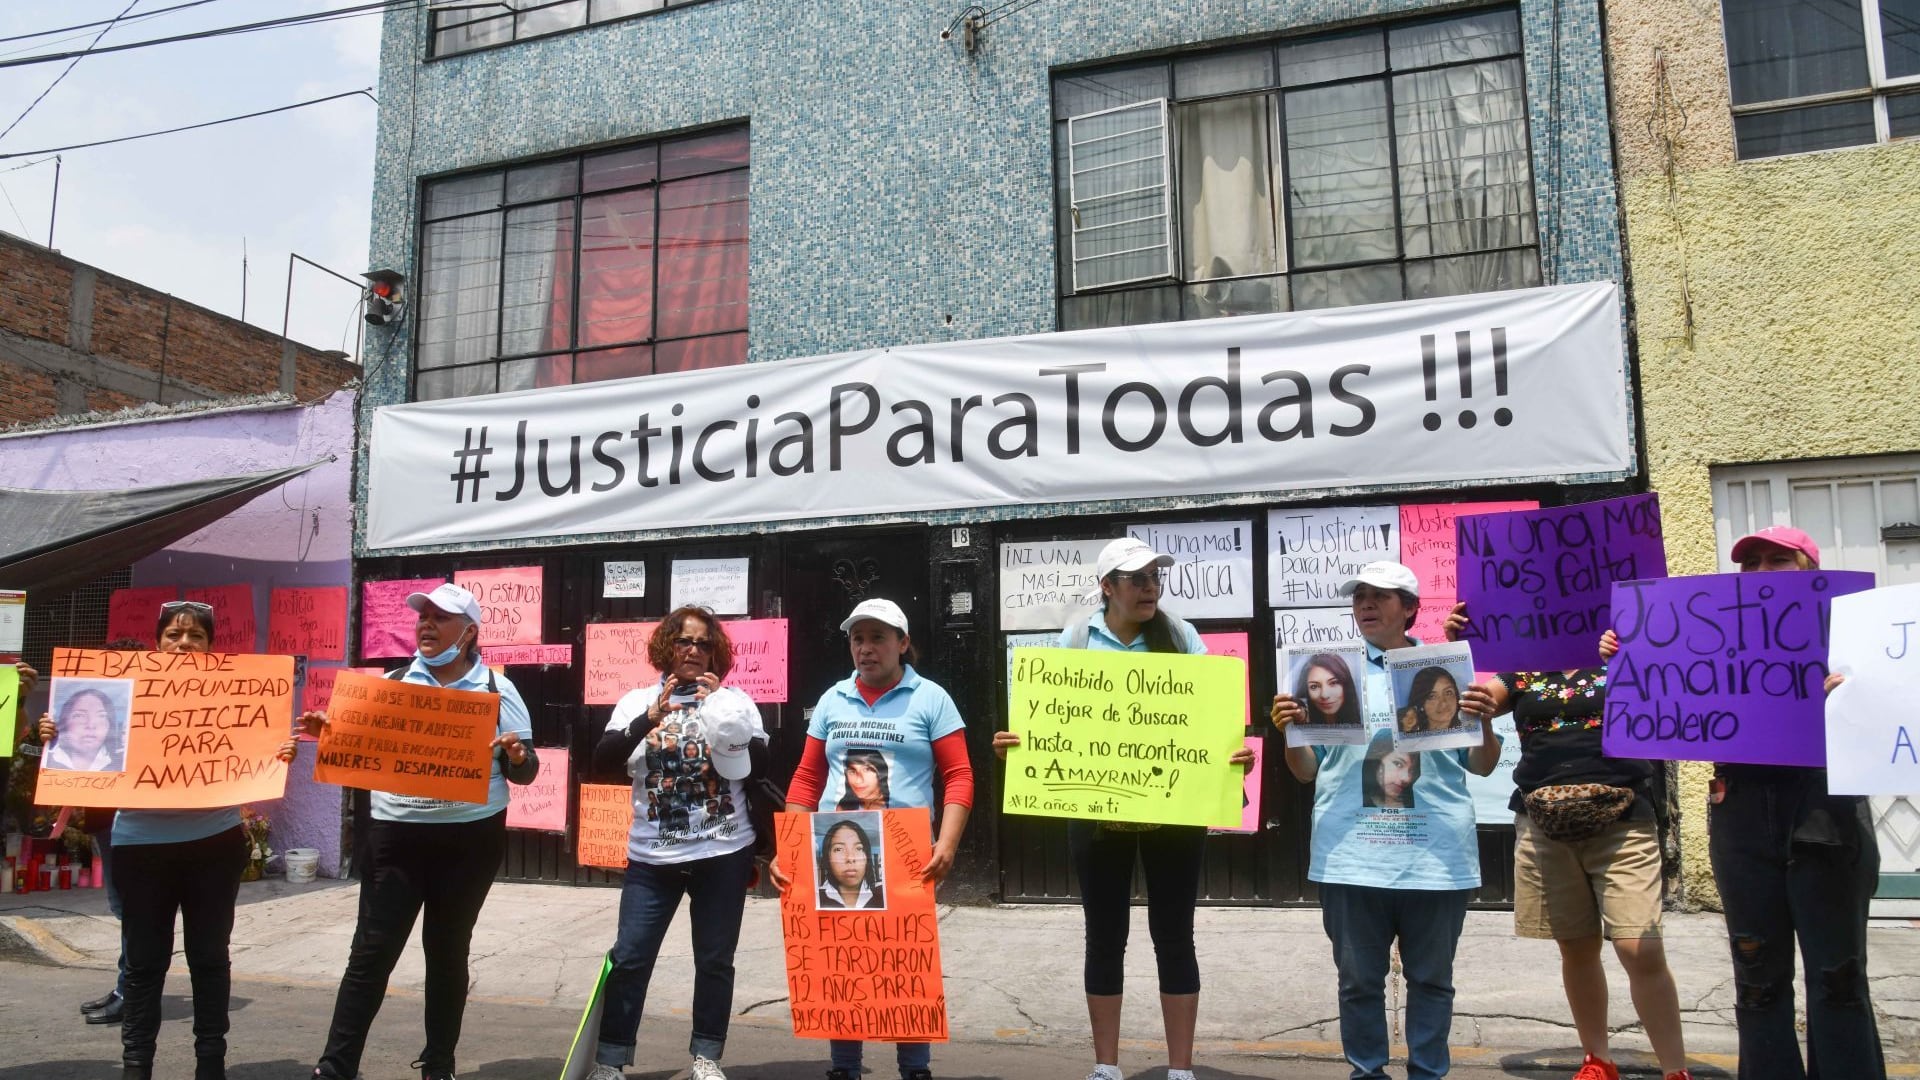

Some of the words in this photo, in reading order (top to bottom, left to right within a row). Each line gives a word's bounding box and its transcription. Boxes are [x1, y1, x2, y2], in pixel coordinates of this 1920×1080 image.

[450, 347, 1377, 504] #JusticiaParaTodas
[1421, 327, 1514, 431] !!!
[953, 529, 968, 543] 18
[1277, 514, 1392, 555] ¡Justicia!
[1040, 548, 1082, 566] UNA
[1281, 556, 1320, 580] para
[1481, 558, 1547, 594] nos
[489, 582, 541, 604] estamos
[1072, 594, 1102, 606] TOD
[587, 625, 607, 641] Las
[131, 704, 270, 730] JUSTICIA
[860, 720, 897, 731] MICHAEL
[1102, 706, 1121, 723] de
[1605, 700, 1739, 743] Roblero
[161, 731, 234, 757] PARA
[861, 730, 905, 743] MARTÍNEZ
[1089, 738, 1111, 757] no
[318, 751, 382, 771] MUJERES
[394, 760, 483, 780] DESAPARECIDAS
[1087, 801, 1103, 814] sin
[1108, 797, 1119, 814] ti
[782, 914, 811, 940] LAS
[818, 913, 936, 943] FISCALIAS
[786, 944, 815, 972] SE
[819, 945, 934, 976] TARDARON
[791, 973, 815, 1005] 12
[822, 973, 868, 1004] AÑOS
[872, 974, 926, 1000] PARA
